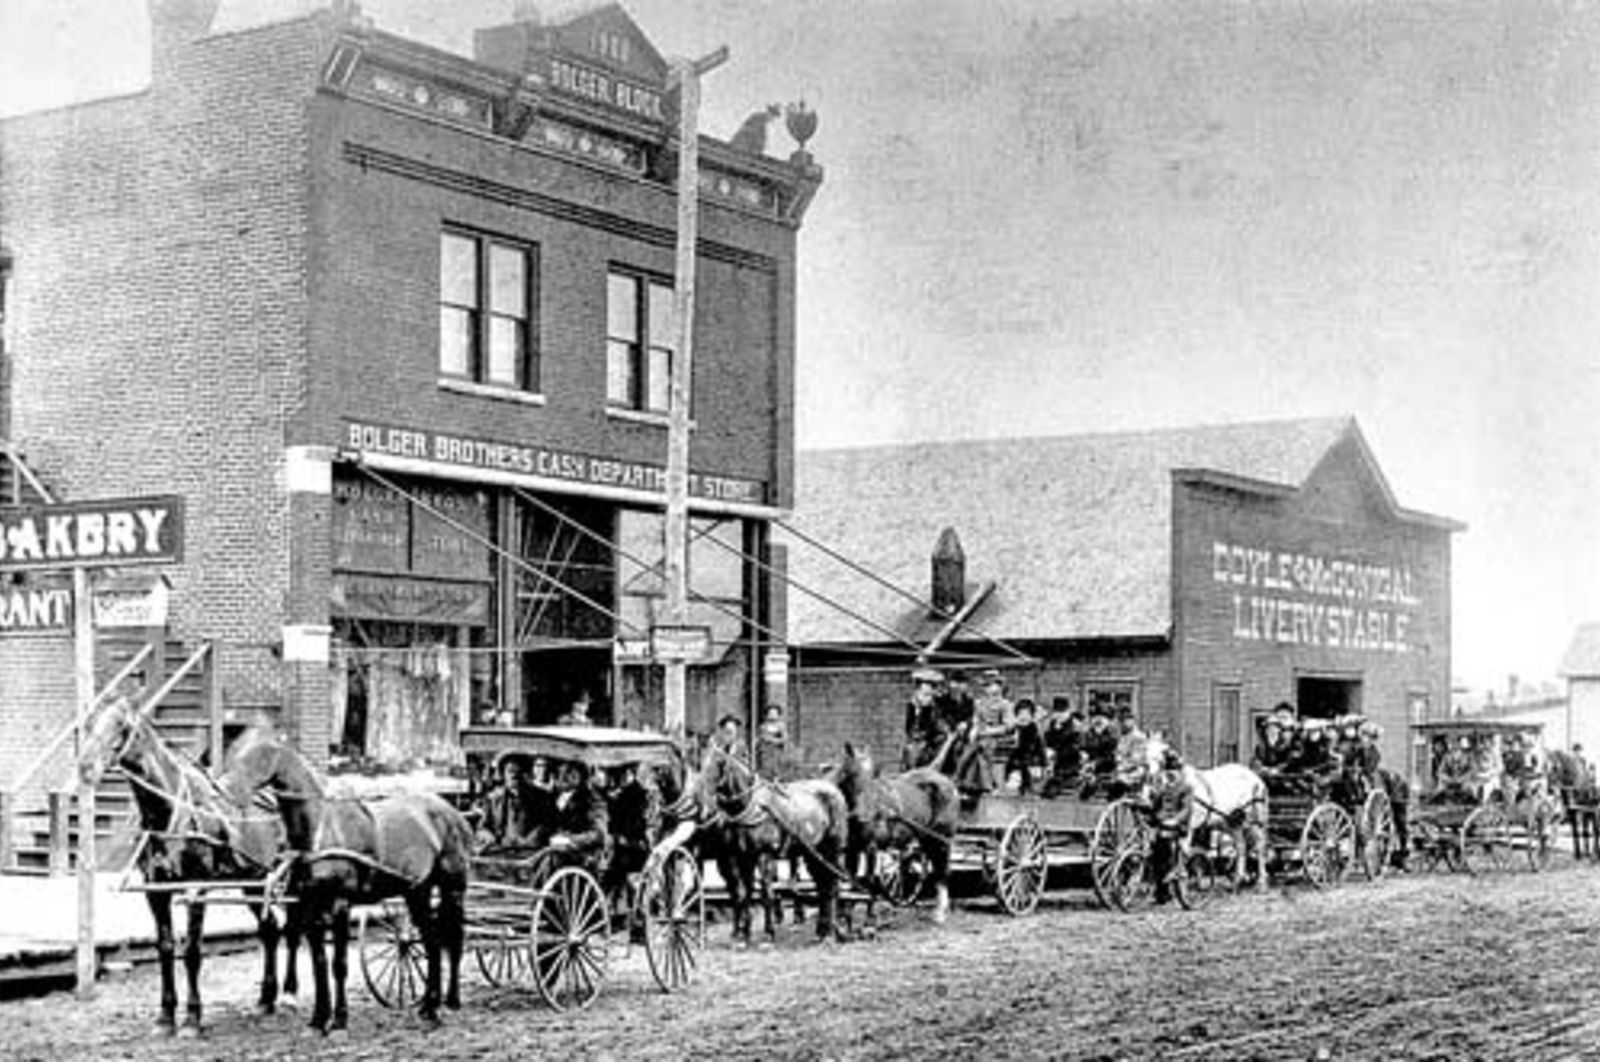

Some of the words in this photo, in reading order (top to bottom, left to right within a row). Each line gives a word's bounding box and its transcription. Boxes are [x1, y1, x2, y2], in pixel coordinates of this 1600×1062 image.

[551, 60, 611, 104] BOLGER
[349, 422, 427, 458] BOLGER
[433, 434, 533, 473] BROTHERS
[1232, 593, 1324, 646] LIVERY
[1326, 605, 1412, 652] STABLE
